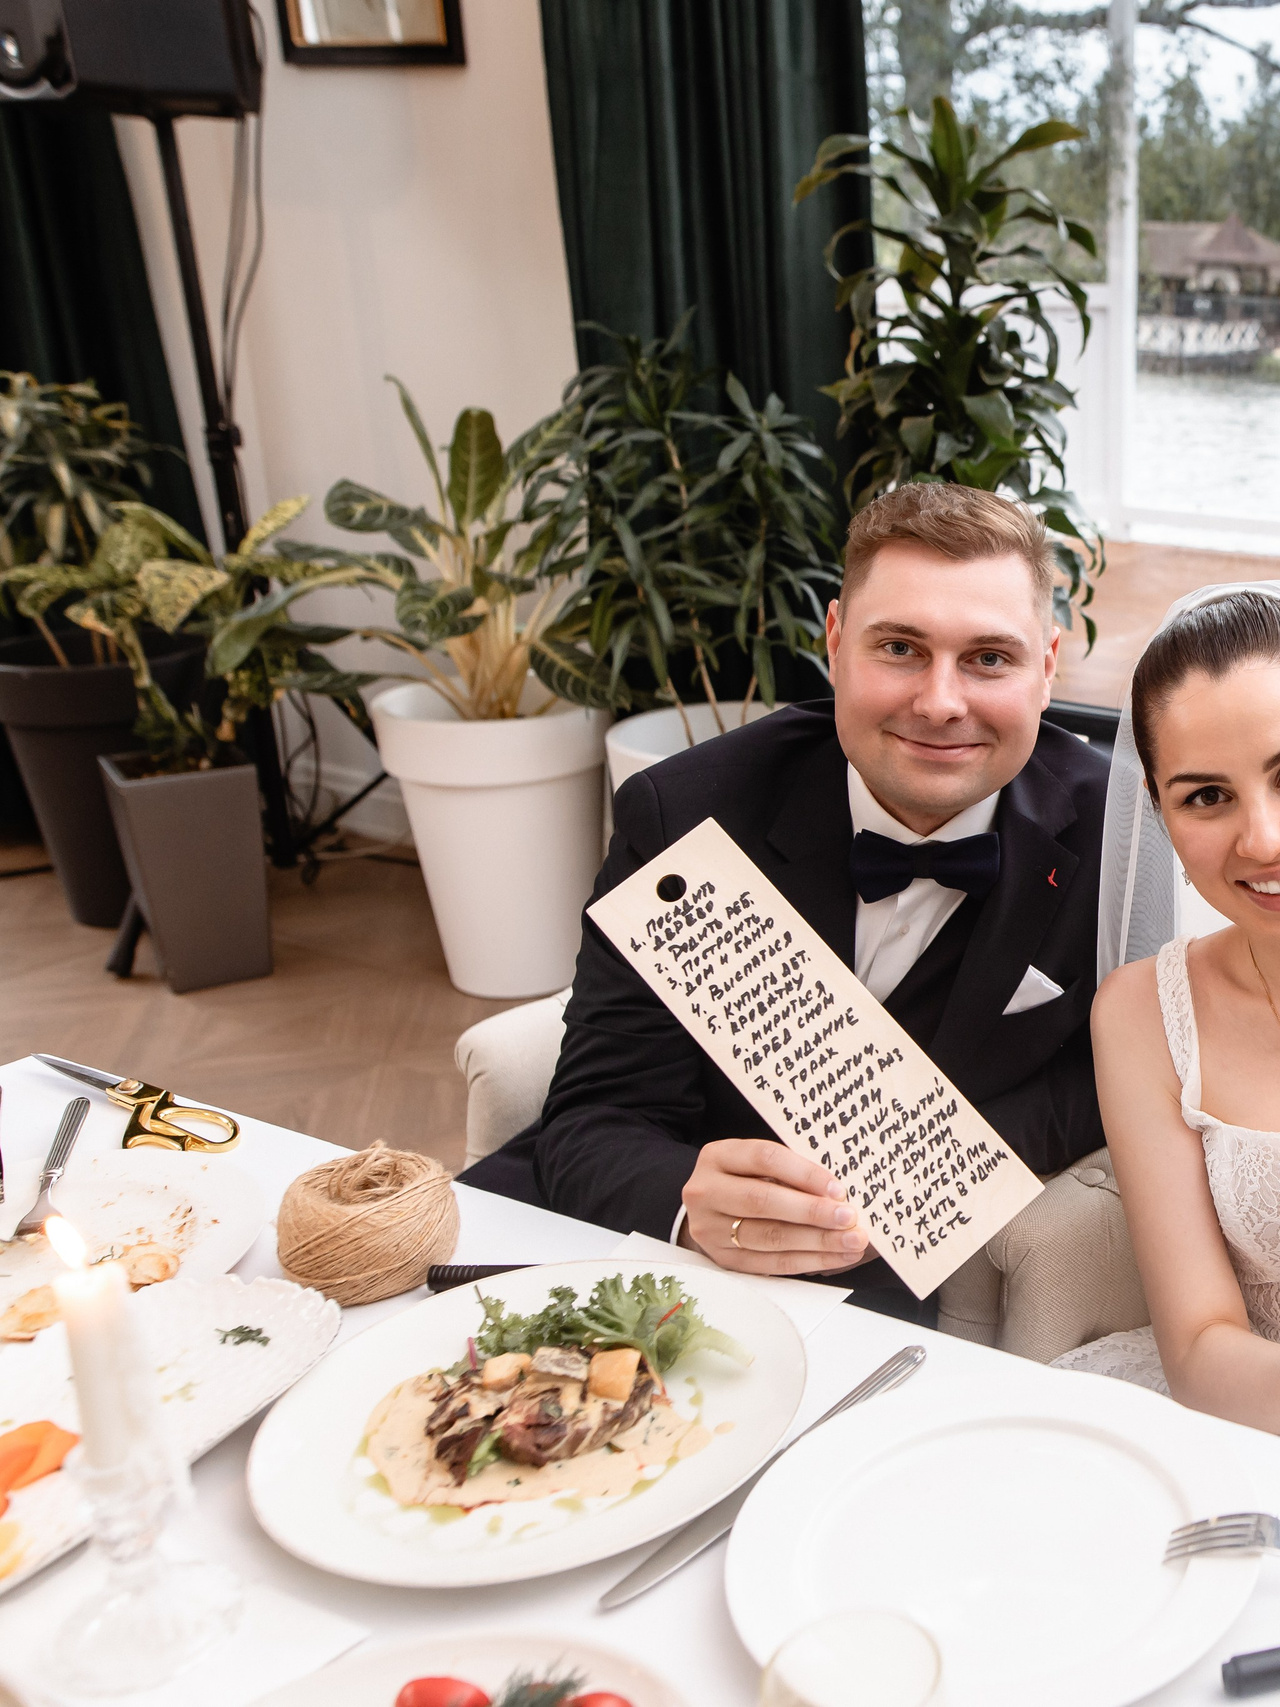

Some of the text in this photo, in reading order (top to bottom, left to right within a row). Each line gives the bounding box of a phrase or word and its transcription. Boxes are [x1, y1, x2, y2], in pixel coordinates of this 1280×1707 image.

[646, 881, 715, 937] ПОСАДИТЬ
[653, 900, 714, 952] ДЕРЕВО
[654, 891, 755, 974] 2. РОДИТЬ РЕБ.
[667, 913, 761, 990] 3. ПОСТРОИТЬ
[685, 917, 775, 997] ДОМ И БАНЮ
[692, 930, 792, 1017] 4. ВЫСПАТЬСЯ
[707, 1015, 721, 1034] 5.
[730, 972, 804, 1035] КРОВАТКУ
[732, 980, 826, 1059] 6. МИРИТЬСЯ
[744, 993, 834, 1074] ПЕРЕД СНОМ
[754, 1007, 859, 1090] 7. СВИДАНИЕ
[773, 1089, 785, 1104] В
[783, 1107, 798, 1121] 8.
[794, 1048, 903, 1135] СВИДАНИЯ РАЗ
[879, 1076, 945, 1145] ОТКРЫТИЙ
[821, 1098, 904, 1169] 9. БОЛЬШЕ
[846, 1098, 958, 1202] 10. НАСЛАЖДАТЬСЯ
[862, 1125, 952, 1209] ДРУГ ДРУГОМ
[882, 1141, 990, 1236] С РОДИТЕЛЯМИ
[883, 1189, 905, 1213] НЕ
[914, 1195, 956, 1235] ЖИТЬ
[955, 1180, 968, 1197] В
[913, 1211, 972, 1259] МЕСТЕ
